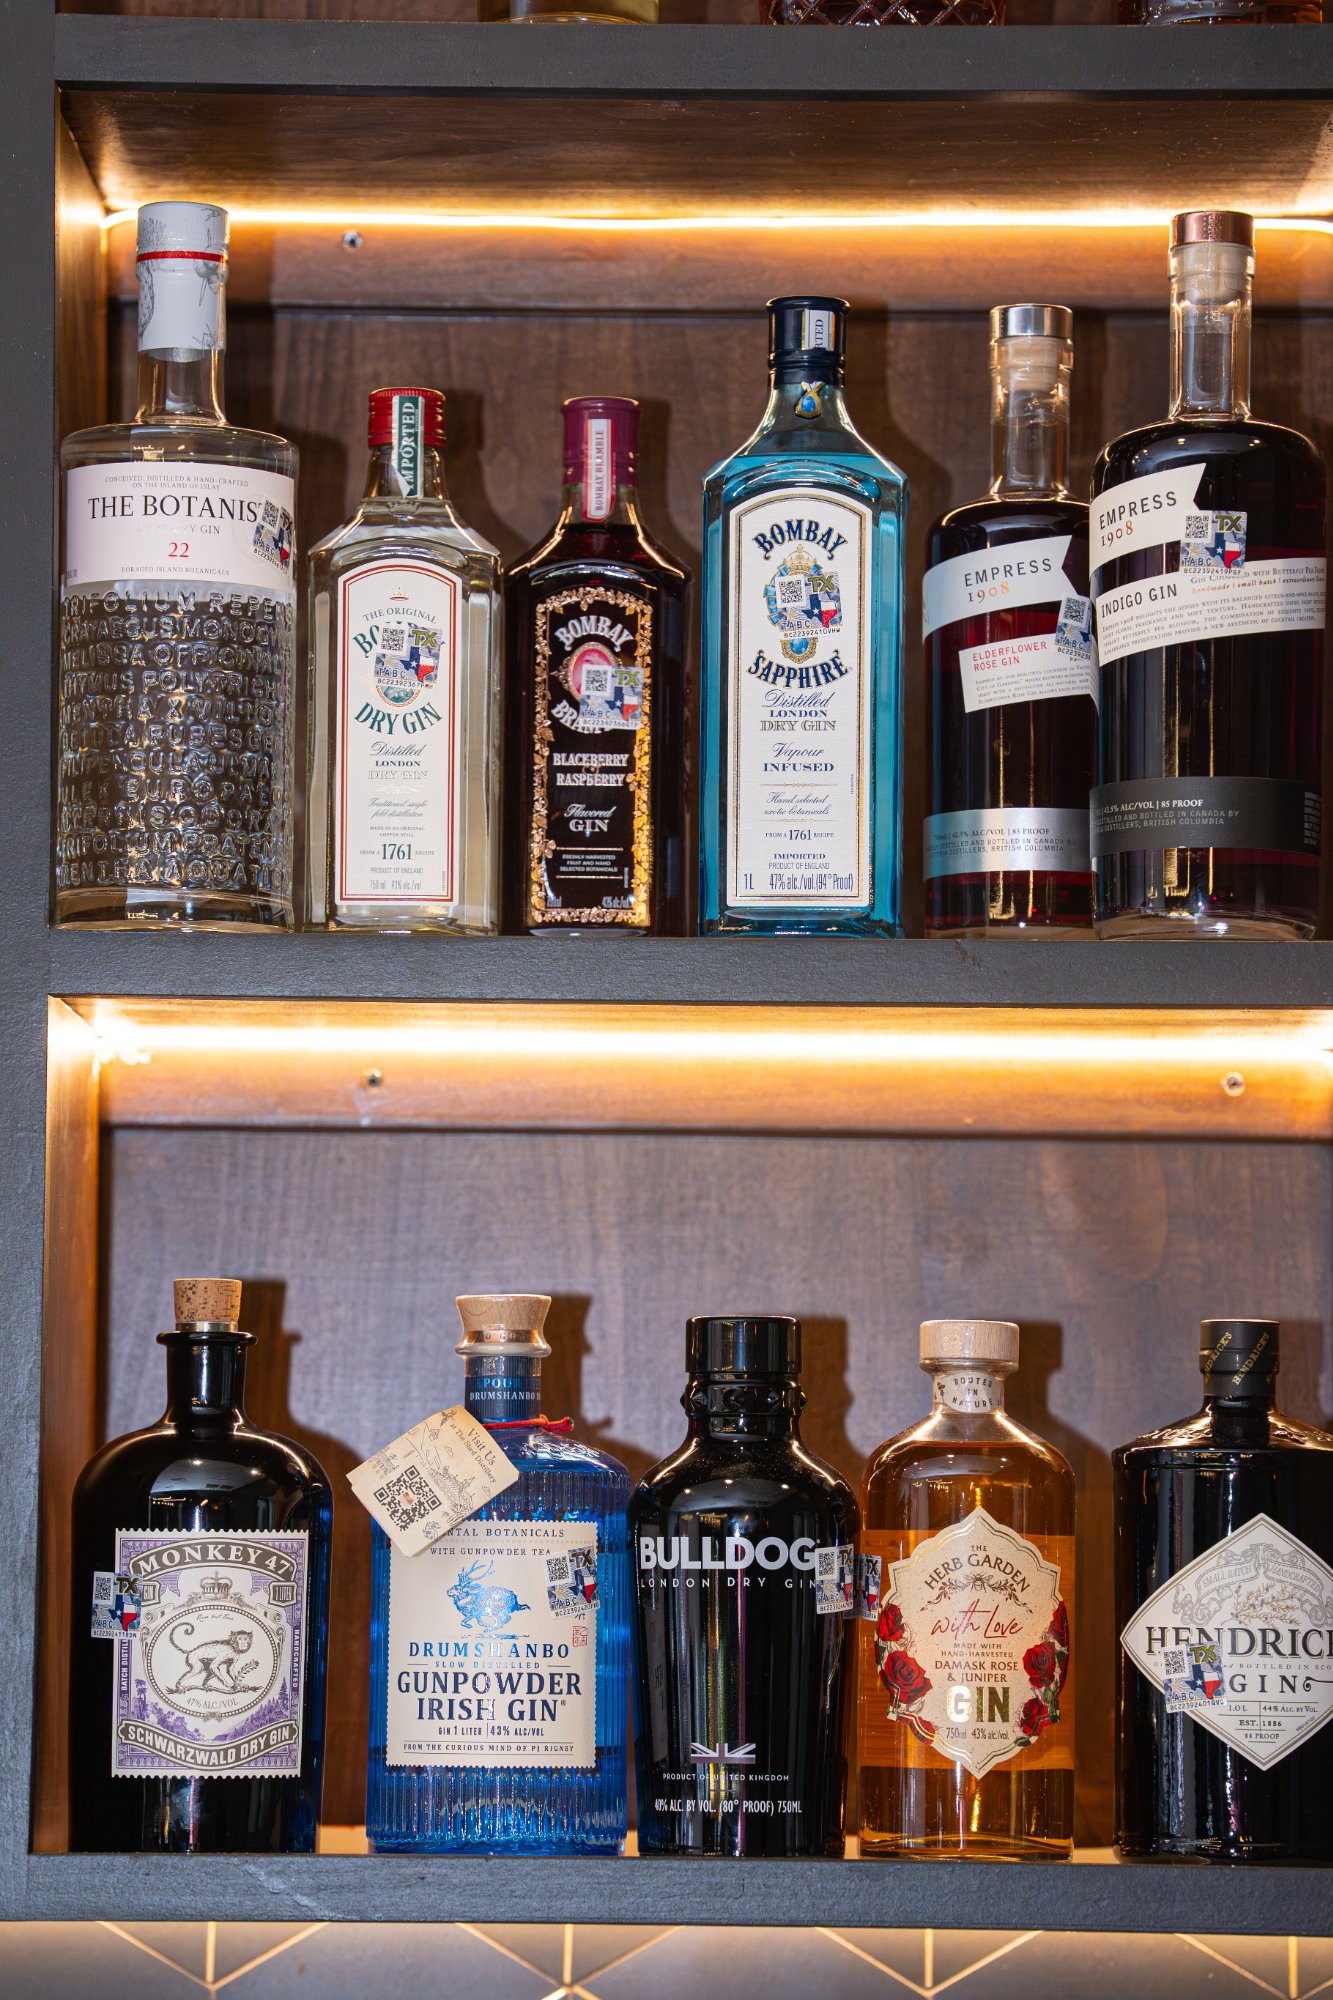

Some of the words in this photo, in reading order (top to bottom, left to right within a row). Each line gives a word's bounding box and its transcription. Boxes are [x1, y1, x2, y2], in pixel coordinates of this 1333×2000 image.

[88, 495, 134, 519] THE
[1100, 491, 1177, 530] EMPRESS
[200, 525, 220, 535] GIN
[1215, 514, 1242, 532] TX
[752, 519, 848, 561] BOMBAY
[1101, 520, 1133, 548] 1908
[168, 542, 189, 557] 22
[185, 567, 229, 576] BOTANICALS
[964, 558, 1052, 587] EMPRESS
[807, 575, 835, 593] TX
[968, 580, 1010, 603] 1908
[1101, 593, 1143, 618] INDIGO
[1149, 583, 1177, 602] GIN
[363, 608, 384, 621] THE
[386, 608, 437, 624] ORIGINAL
[411, 630, 437, 648] TX
[554, 615, 634, 652] BOMBAY
[972, 641, 1048, 661] ELDERFLOWER
[747, 649, 848, 689] SAPPHIRE
[973, 659, 997, 672] ROSE
[1001, 655, 1020, 667] GIN
[614, 670, 640, 686] TX
[762, 689, 835, 708] Distilled
[354, 702, 399, 735] DRY
[402, 702, 442, 735] GIN
[760, 720, 798, 732] DRY
[801, 720, 837, 731] GIN
[370, 741, 427, 757] Distilled
[772, 742, 824, 761] Vapour
[553, 753, 629, 766] BLACKBERRY
[763, 763, 834, 772] INFUSED
[368, 770, 397, 780] DRY
[401, 770, 428, 780] GIN
[556, 773, 625, 786] RASPBERRY
[564, 804, 617, 818] Flavored
[787, 804, 830, 815] botanicals
[1120, 801, 1154, 811] ALC/VOL
[1161, 800, 1170, 808] 85
[1173, 799, 1203, 808] PROOF
[1124, 813, 1138, 821] AND
[1140, 811, 1174, 819] BOTTLED
[1144, 819, 1176, 827] BRITISH
[1179, 817, 1225, 825] COLUMBIA
[569, 819, 609, 832] GIN
[972, 828, 1005, 836] ALC/VOL
[788, 830, 812, 840] 1761
[381, 843, 412, 860] 1761
[450, 1423, 458, 1431] at
[455, 1429, 467, 1443] The
[463, 1440, 477, 1456] Shed
[473, 1452, 497, 1484] Distillery
[467, 1428, 486, 1455] Visit
[484, 1452, 497, 1467] Us
[486, 1529, 565, 1537] BOTANICALS
[137, 1544, 262, 1575] MONKEY
[264, 1554, 290, 1575] 47
[430, 1547, 456, 1555] WITH
[461, 1547, 526, 1556] GUNPOWDER
[532, 1548, 551, 1556] TEA
[572, 1550, 594, 1568] TX
[640, 1537, 816, 1570] BULLDOG
[866, 1558, 878, 1575] TX
[924, 1557, 963, 1590] HERB
[968, 1554, 1030, 1593] GARDEN
[116, 1577, 139, 1593] TX
[641, 1578, 710, 1588] LONDON
[728, 1577, 766, 1587] DRY
[785, 1579, 816, 1589] GIN
[1270, 1567, 1320, 1593] HANDCRAFTED
[931, 1598, 980, 1640] with
[984, 1605, 1024, 1638] Love
[409, 1642, 569, 1659] DRUMSHANBO
[1189, 1645, 1217, 1664] TX
[935, 1661, 986, 1670] DAMASK
[990, 1661, 1018, 1671] ROSE
[397, 1671, 582, 1696] GUNPOWDER
[947, 1673, 955, 1681] &
[960, 1673, 1007, 1683] JUNIPER
[1229, 1673, 1297, 1693] GIN
[417, 1698, 495, 1721] IRISH
[946, 1685, 1010, 1723] GIN
[439, 1727, 451, 1735] GIN
[454, 1725, 458, 1735] 1
[461, 1727, 482, 1736] LITER
[490, 1726, 510, 1736] 43%
[514, 1728, 545, 1736] ALC/VOL
[1239, 1719, 1258, 1727] EST.
[971, 1728, 986, 1739] 43%
[127, 1725, 236, 1766] SCHWARZWALD
[240, 1739, 266, 1760] DRY
[270, 1725, 290, 1745] GIN
[488, 1744, 512, 1752] MIND
[531, 1745, 540, 1753] PJ
[654, 1799, 667, 1811] 40%
[670, 1800, 684, 1812] ALC.
[686, 1800, 695, 1812] BY
[699, 1801, 716, 1812] VOL.
[719, 1800, 739, 1816] (80°
[743, 1801, 774, 1816] PROOF)
[778, 1801, 802, 1813] 750ML
